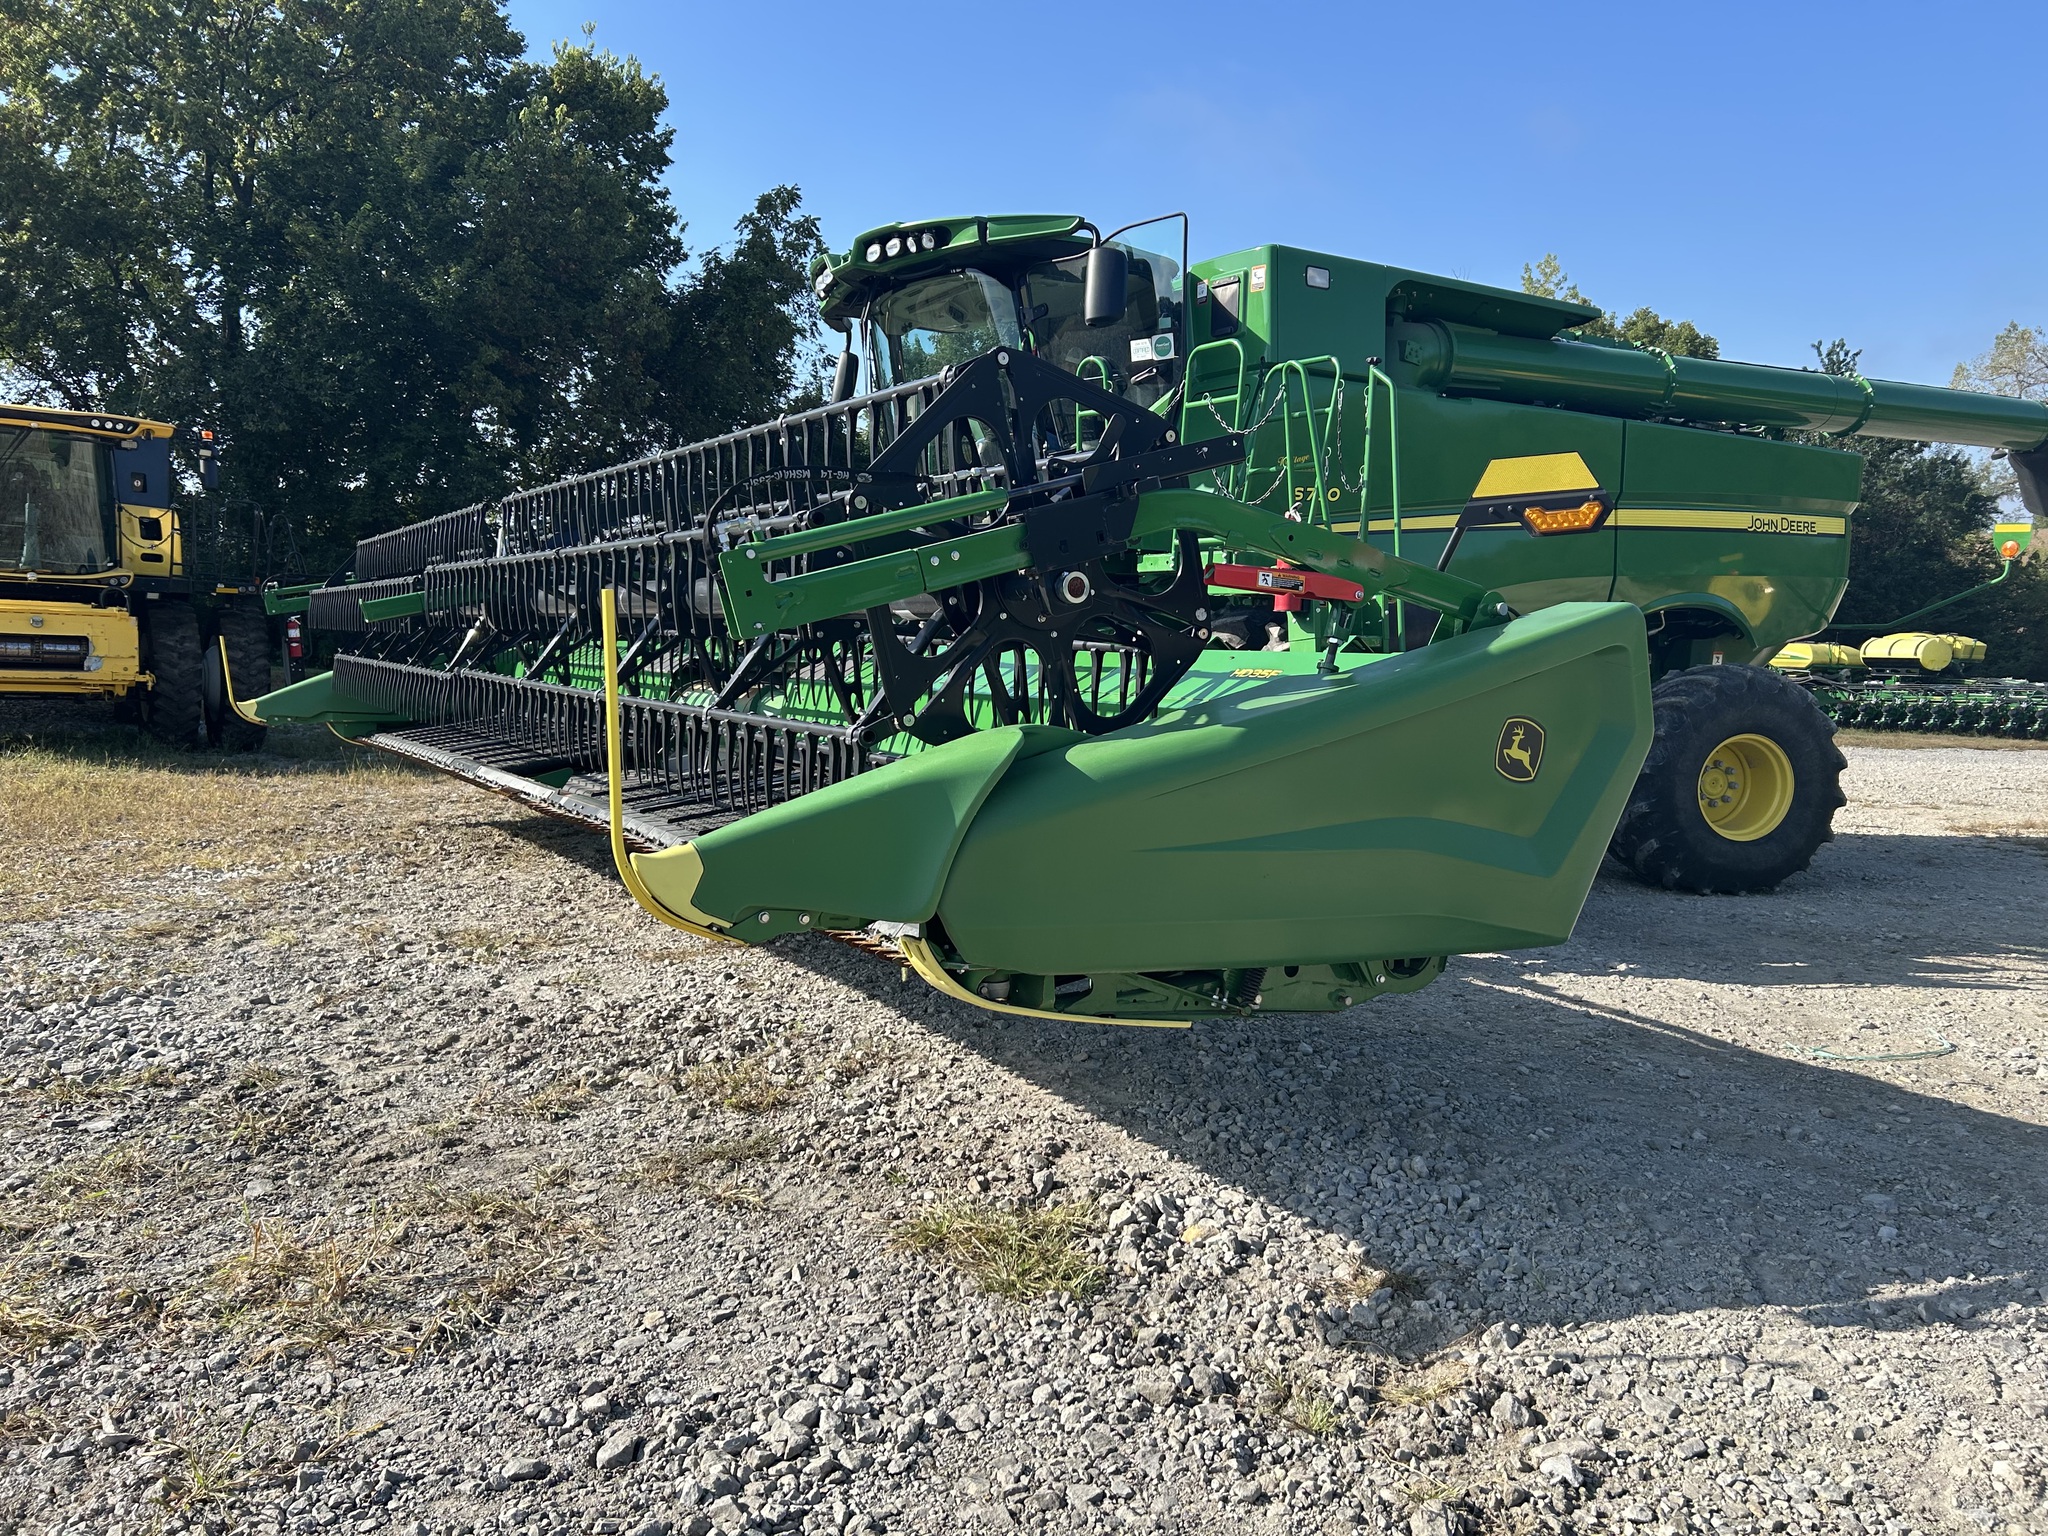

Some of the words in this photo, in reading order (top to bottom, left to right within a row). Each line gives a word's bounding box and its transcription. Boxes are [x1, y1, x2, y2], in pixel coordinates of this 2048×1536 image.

[1294, 486, 1341, 502] S70
[1747, 515, 1779, 531] JOHN
[1780, 517, 1817, 533] DEERE
